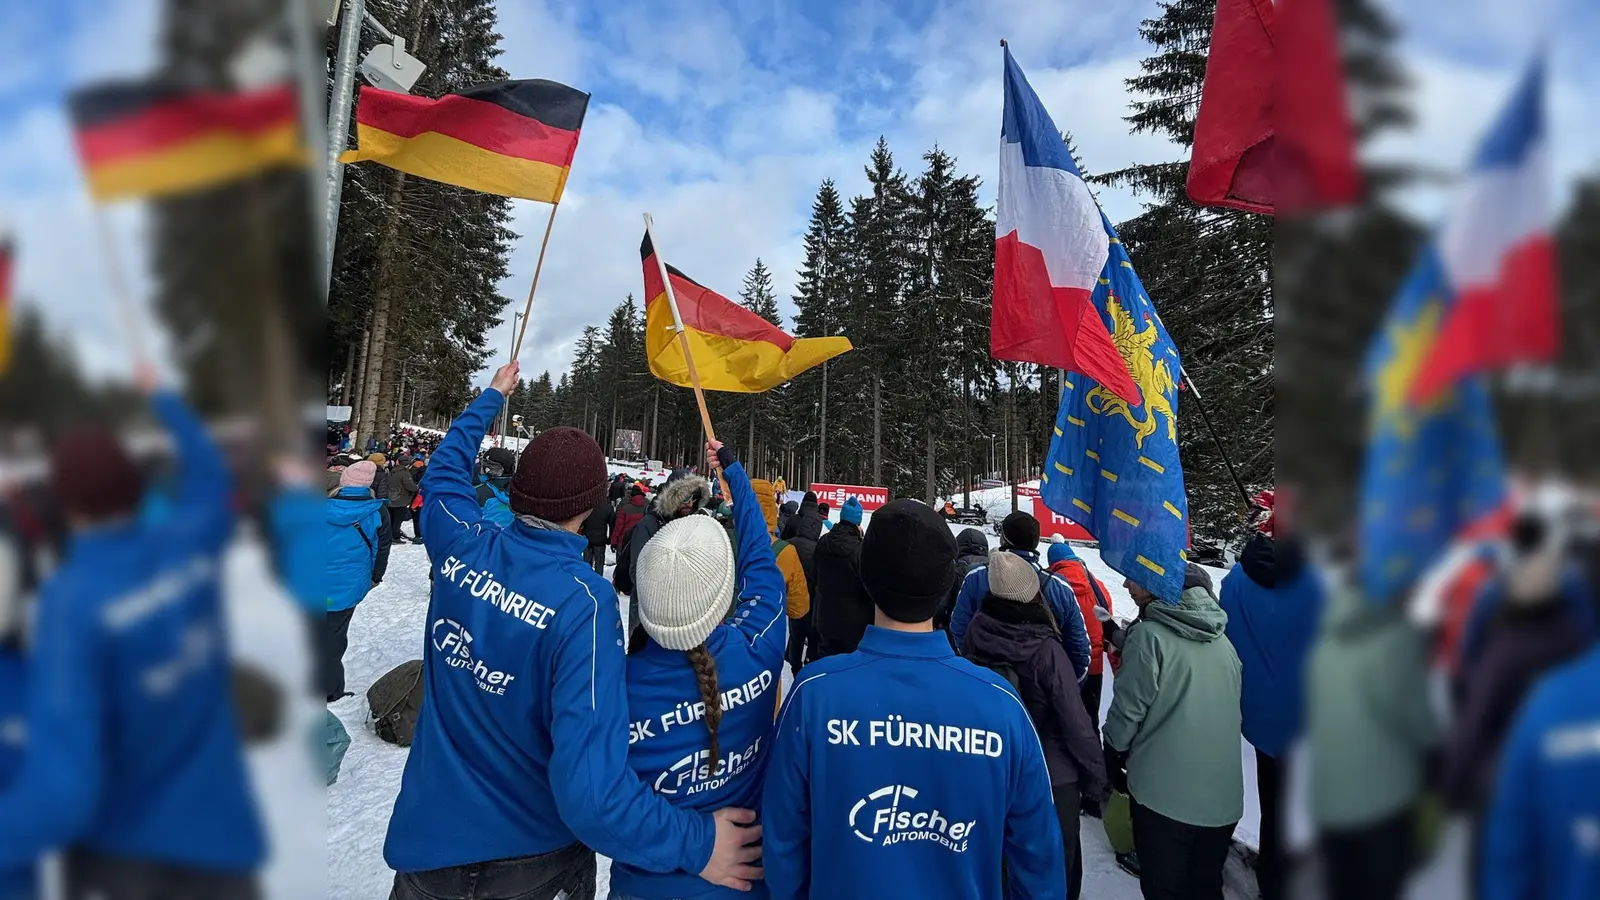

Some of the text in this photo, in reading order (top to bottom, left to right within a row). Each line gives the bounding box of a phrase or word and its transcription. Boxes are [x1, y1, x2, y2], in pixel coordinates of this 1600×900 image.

[812, 488, 886, 506] VIESSMANN
[440, 555, 466, 582] SK
[441, 632, 515, 686] Fisher
[445, 656, 506, 696] AUTOBILE
[629, 719, 655, 744] SK
[827, 714, 1003, 757] SK FÜRNRIED
[677, 736, 761, 787] Fischer
[873, 807, 976, 840] Fischer
[882, 831, 968, 853] AUTOMOBILE
